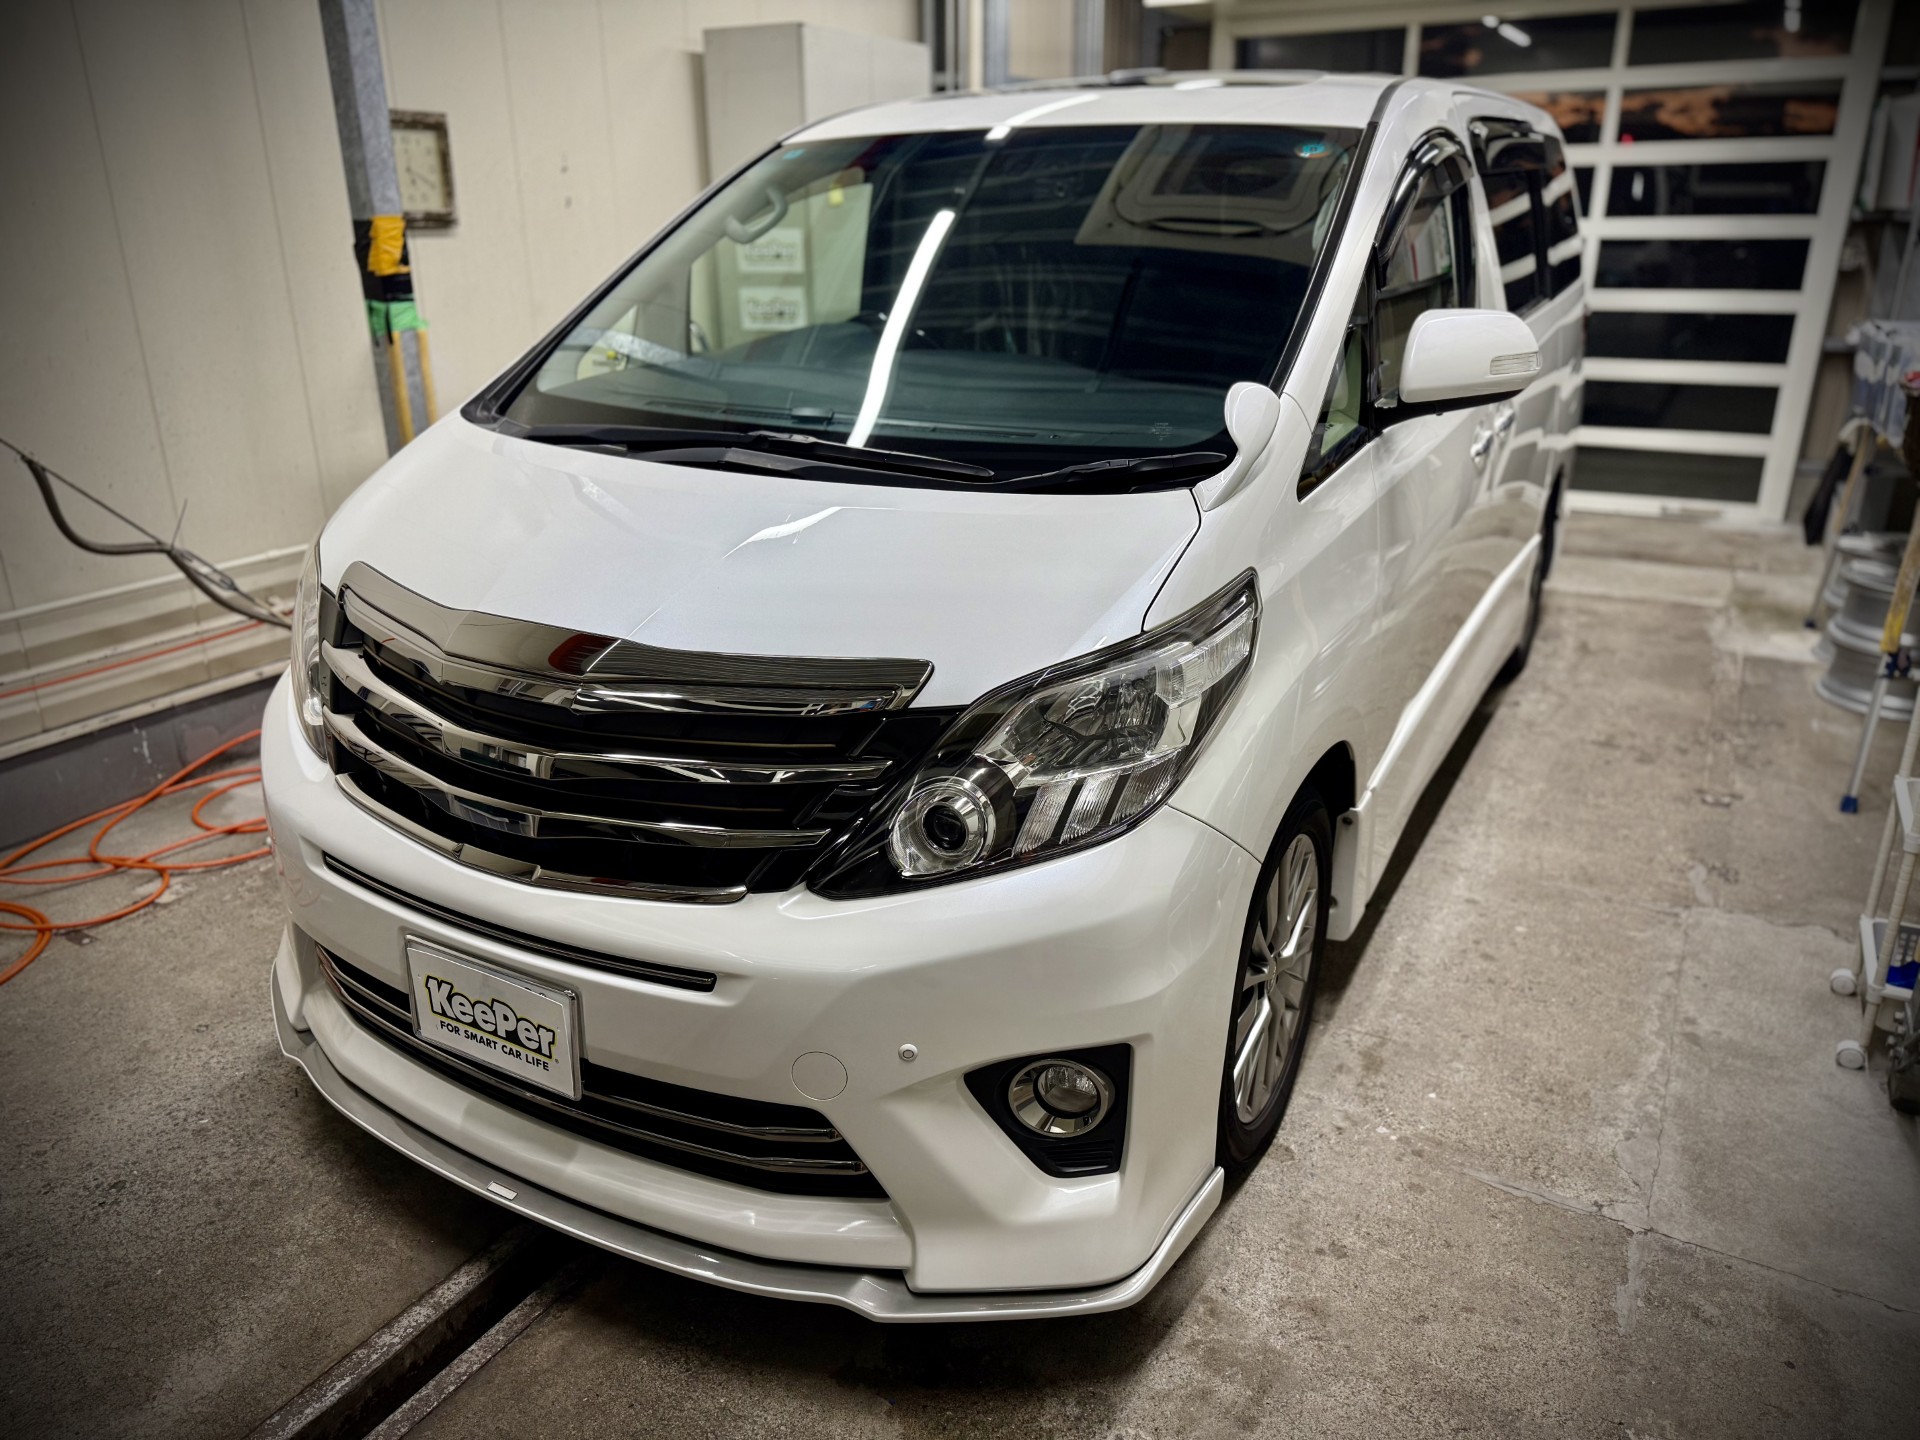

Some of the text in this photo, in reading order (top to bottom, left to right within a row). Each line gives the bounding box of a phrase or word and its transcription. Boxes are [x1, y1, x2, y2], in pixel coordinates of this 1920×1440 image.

[425, 975, 556, 1059] KeePer
[440, 1020, 550, 1071] FOR SMART CAR LIFE
